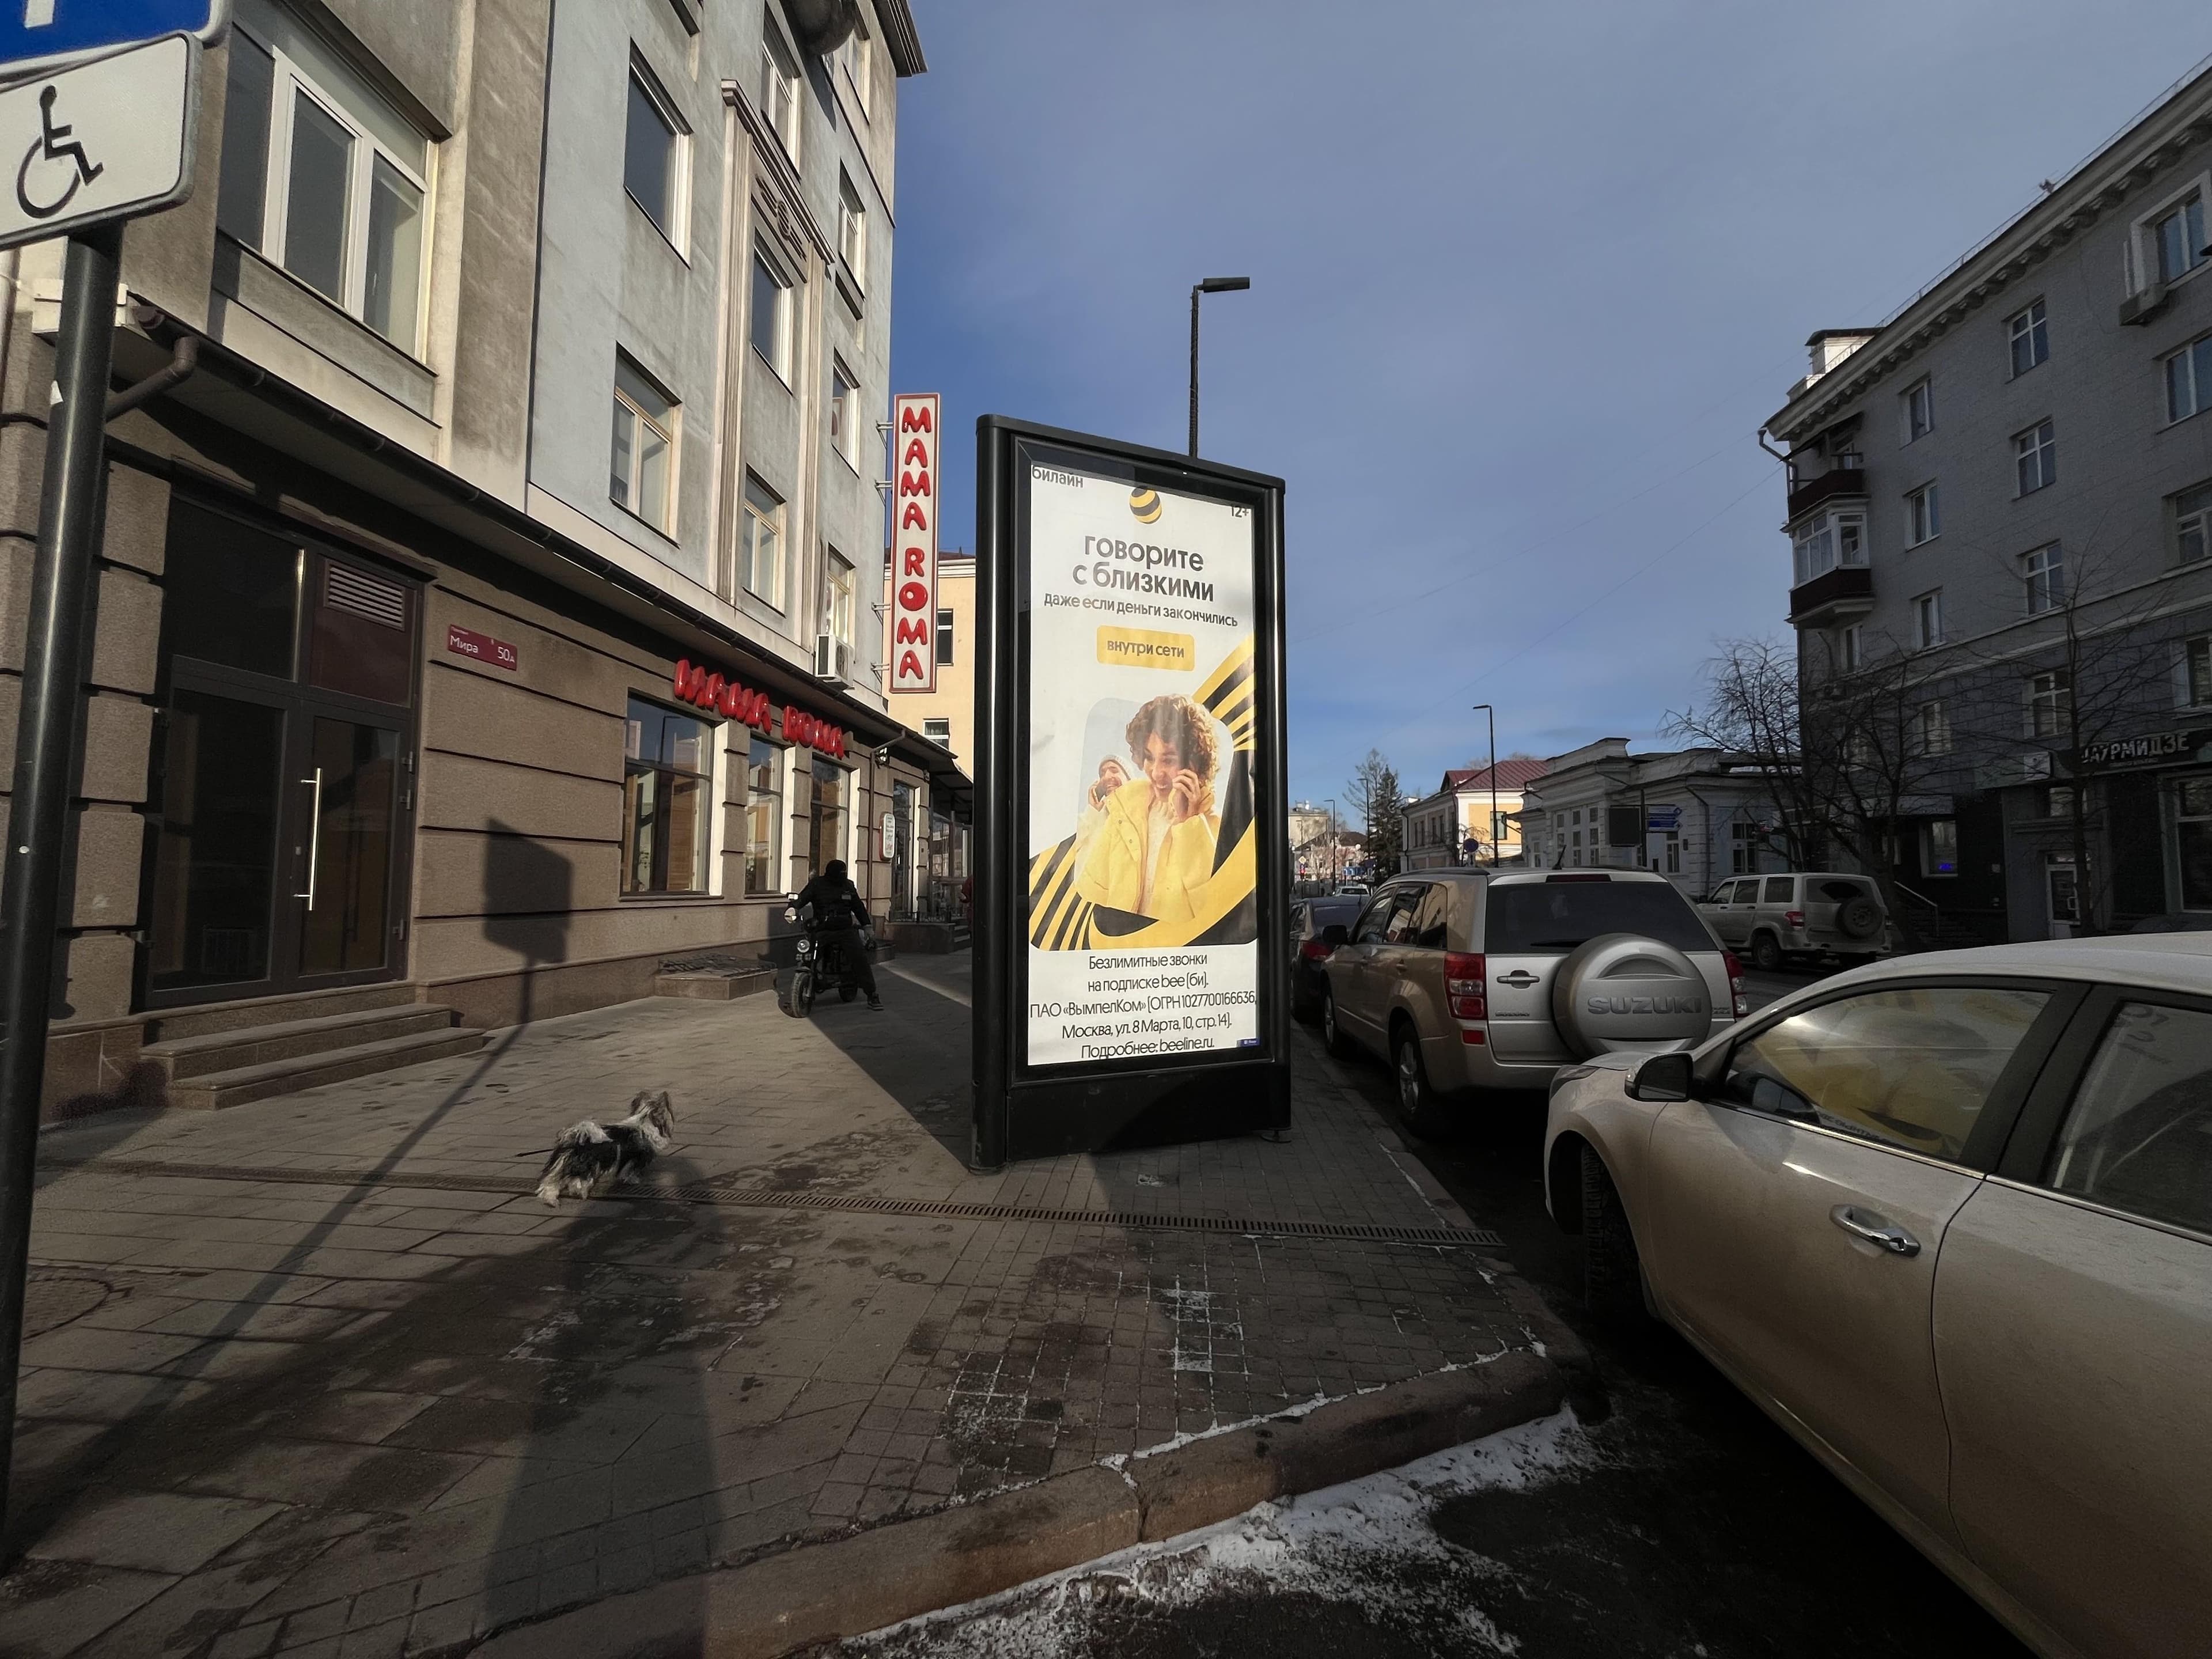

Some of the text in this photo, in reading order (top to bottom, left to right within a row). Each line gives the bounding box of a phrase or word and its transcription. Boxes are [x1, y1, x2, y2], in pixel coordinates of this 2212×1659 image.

[1085, 535, 1204, 571] говорите
[1072, 561, 1214, 601] с близкими
[1044, 592, 1238, 627] даже если деньги закончились
[450, 635, 479, 654] Мира
[1107, 640, 1184, 658] внутри сети
[1089, 953, 1207, 969] Безлимитные звонки
[1088, 981, 1101, 992] на
[1103, 977, 1160, 992] подписке
[1161, 974, 1185, 988] bee
[1030, 1003, 1062, 1018] ПАО
[1587, 997, 1702, 1014] SUZUKI
[1062, 1022, 1113, 1039] Москва,
[1115, 1025, 1130, 1037] ул.
[1133, 1021, 1139, 1033] 8
[1141, 1017, 1180, 1034] Марта,
[1195, 1017, 1216, 1031] стр.
